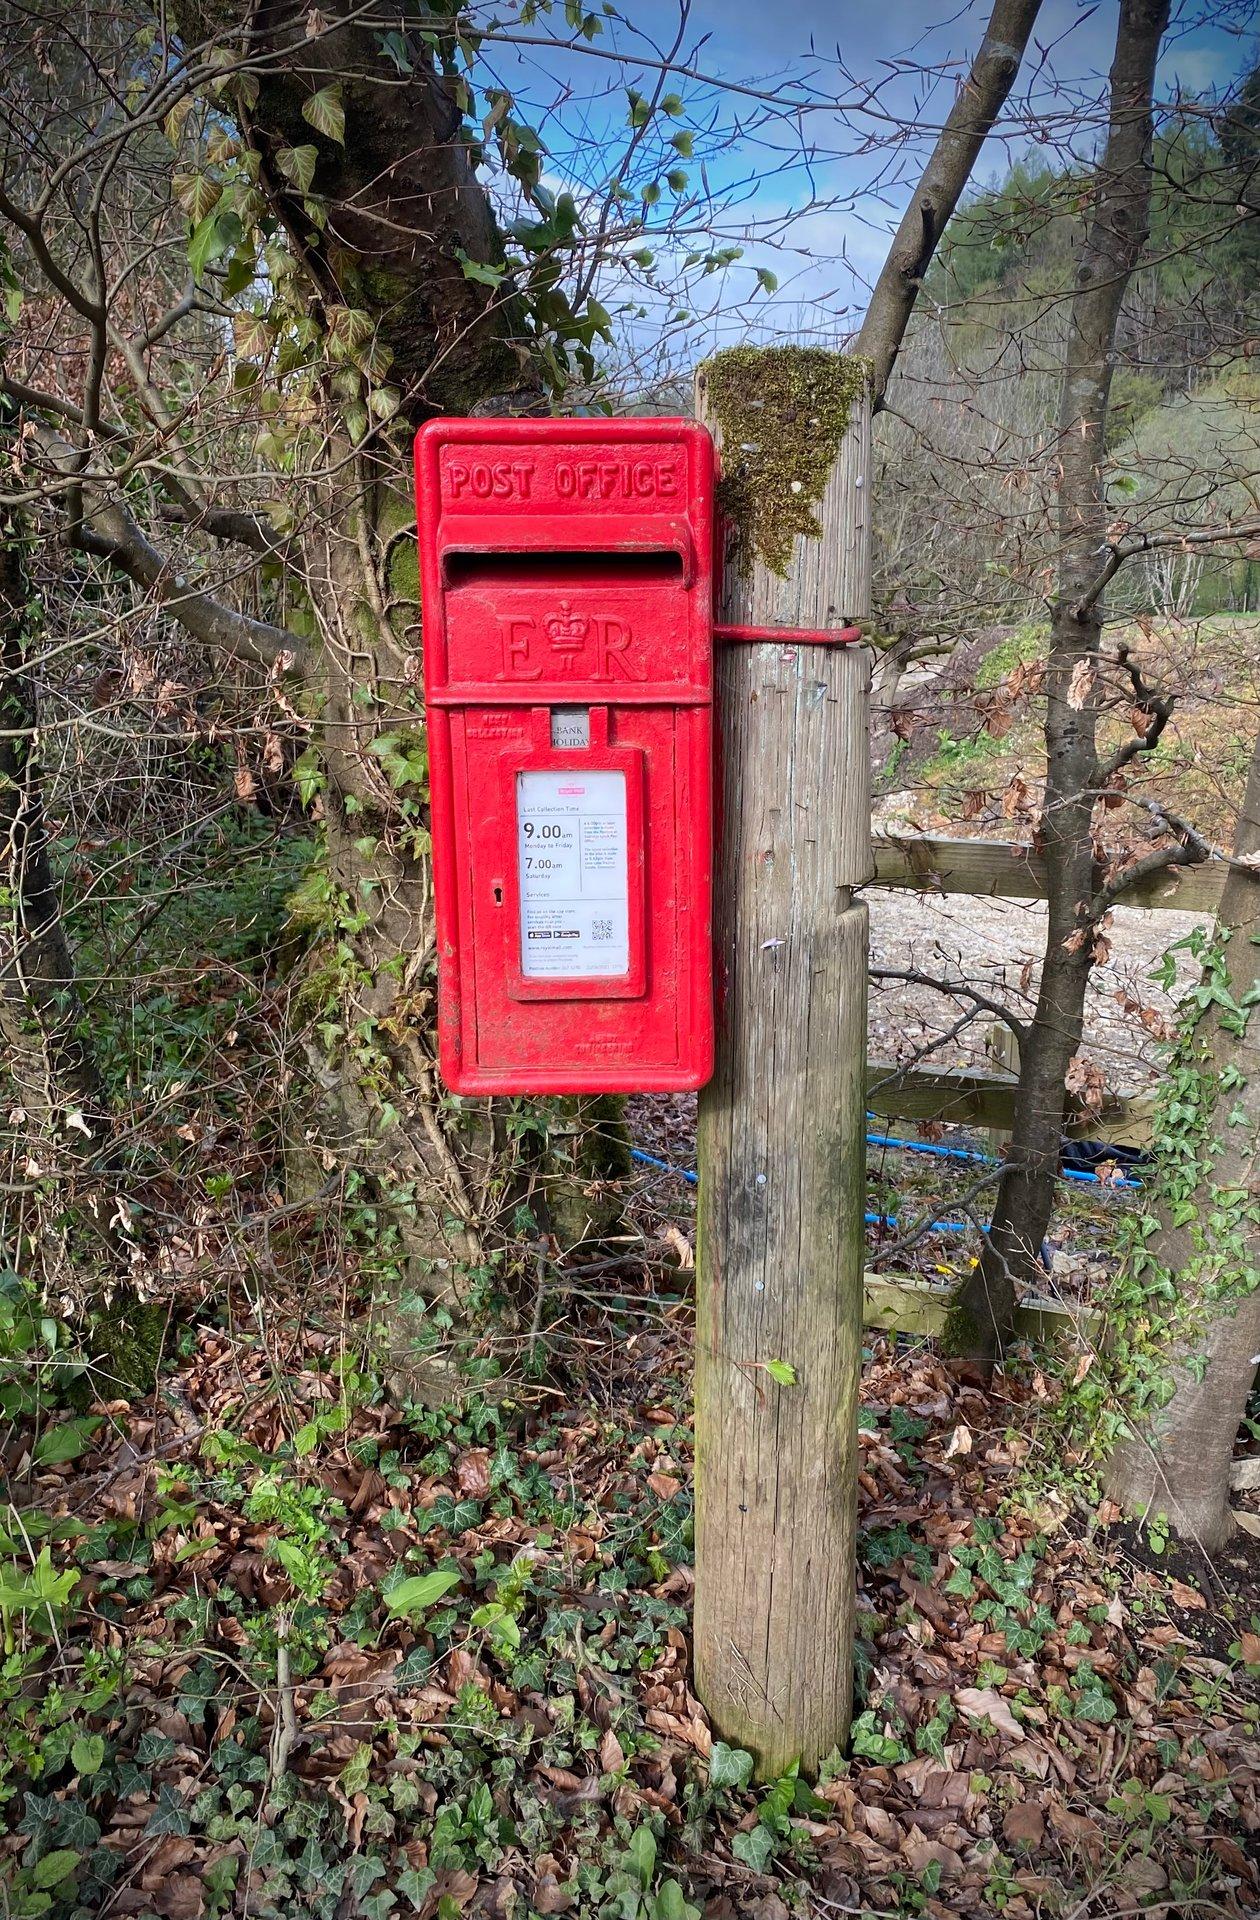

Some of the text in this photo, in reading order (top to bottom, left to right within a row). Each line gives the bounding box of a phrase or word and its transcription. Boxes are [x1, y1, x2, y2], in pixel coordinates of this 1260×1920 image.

[448, 461, 678, 499] POST OFFICE
[495, 613, 648, 682] E R
[556, 726, 583, 735] BANK
[523, 822, 573, 839] 9.00am
[525, 857, 563, 869] 7.00am
[525, 872, 551, 880] Saturday
